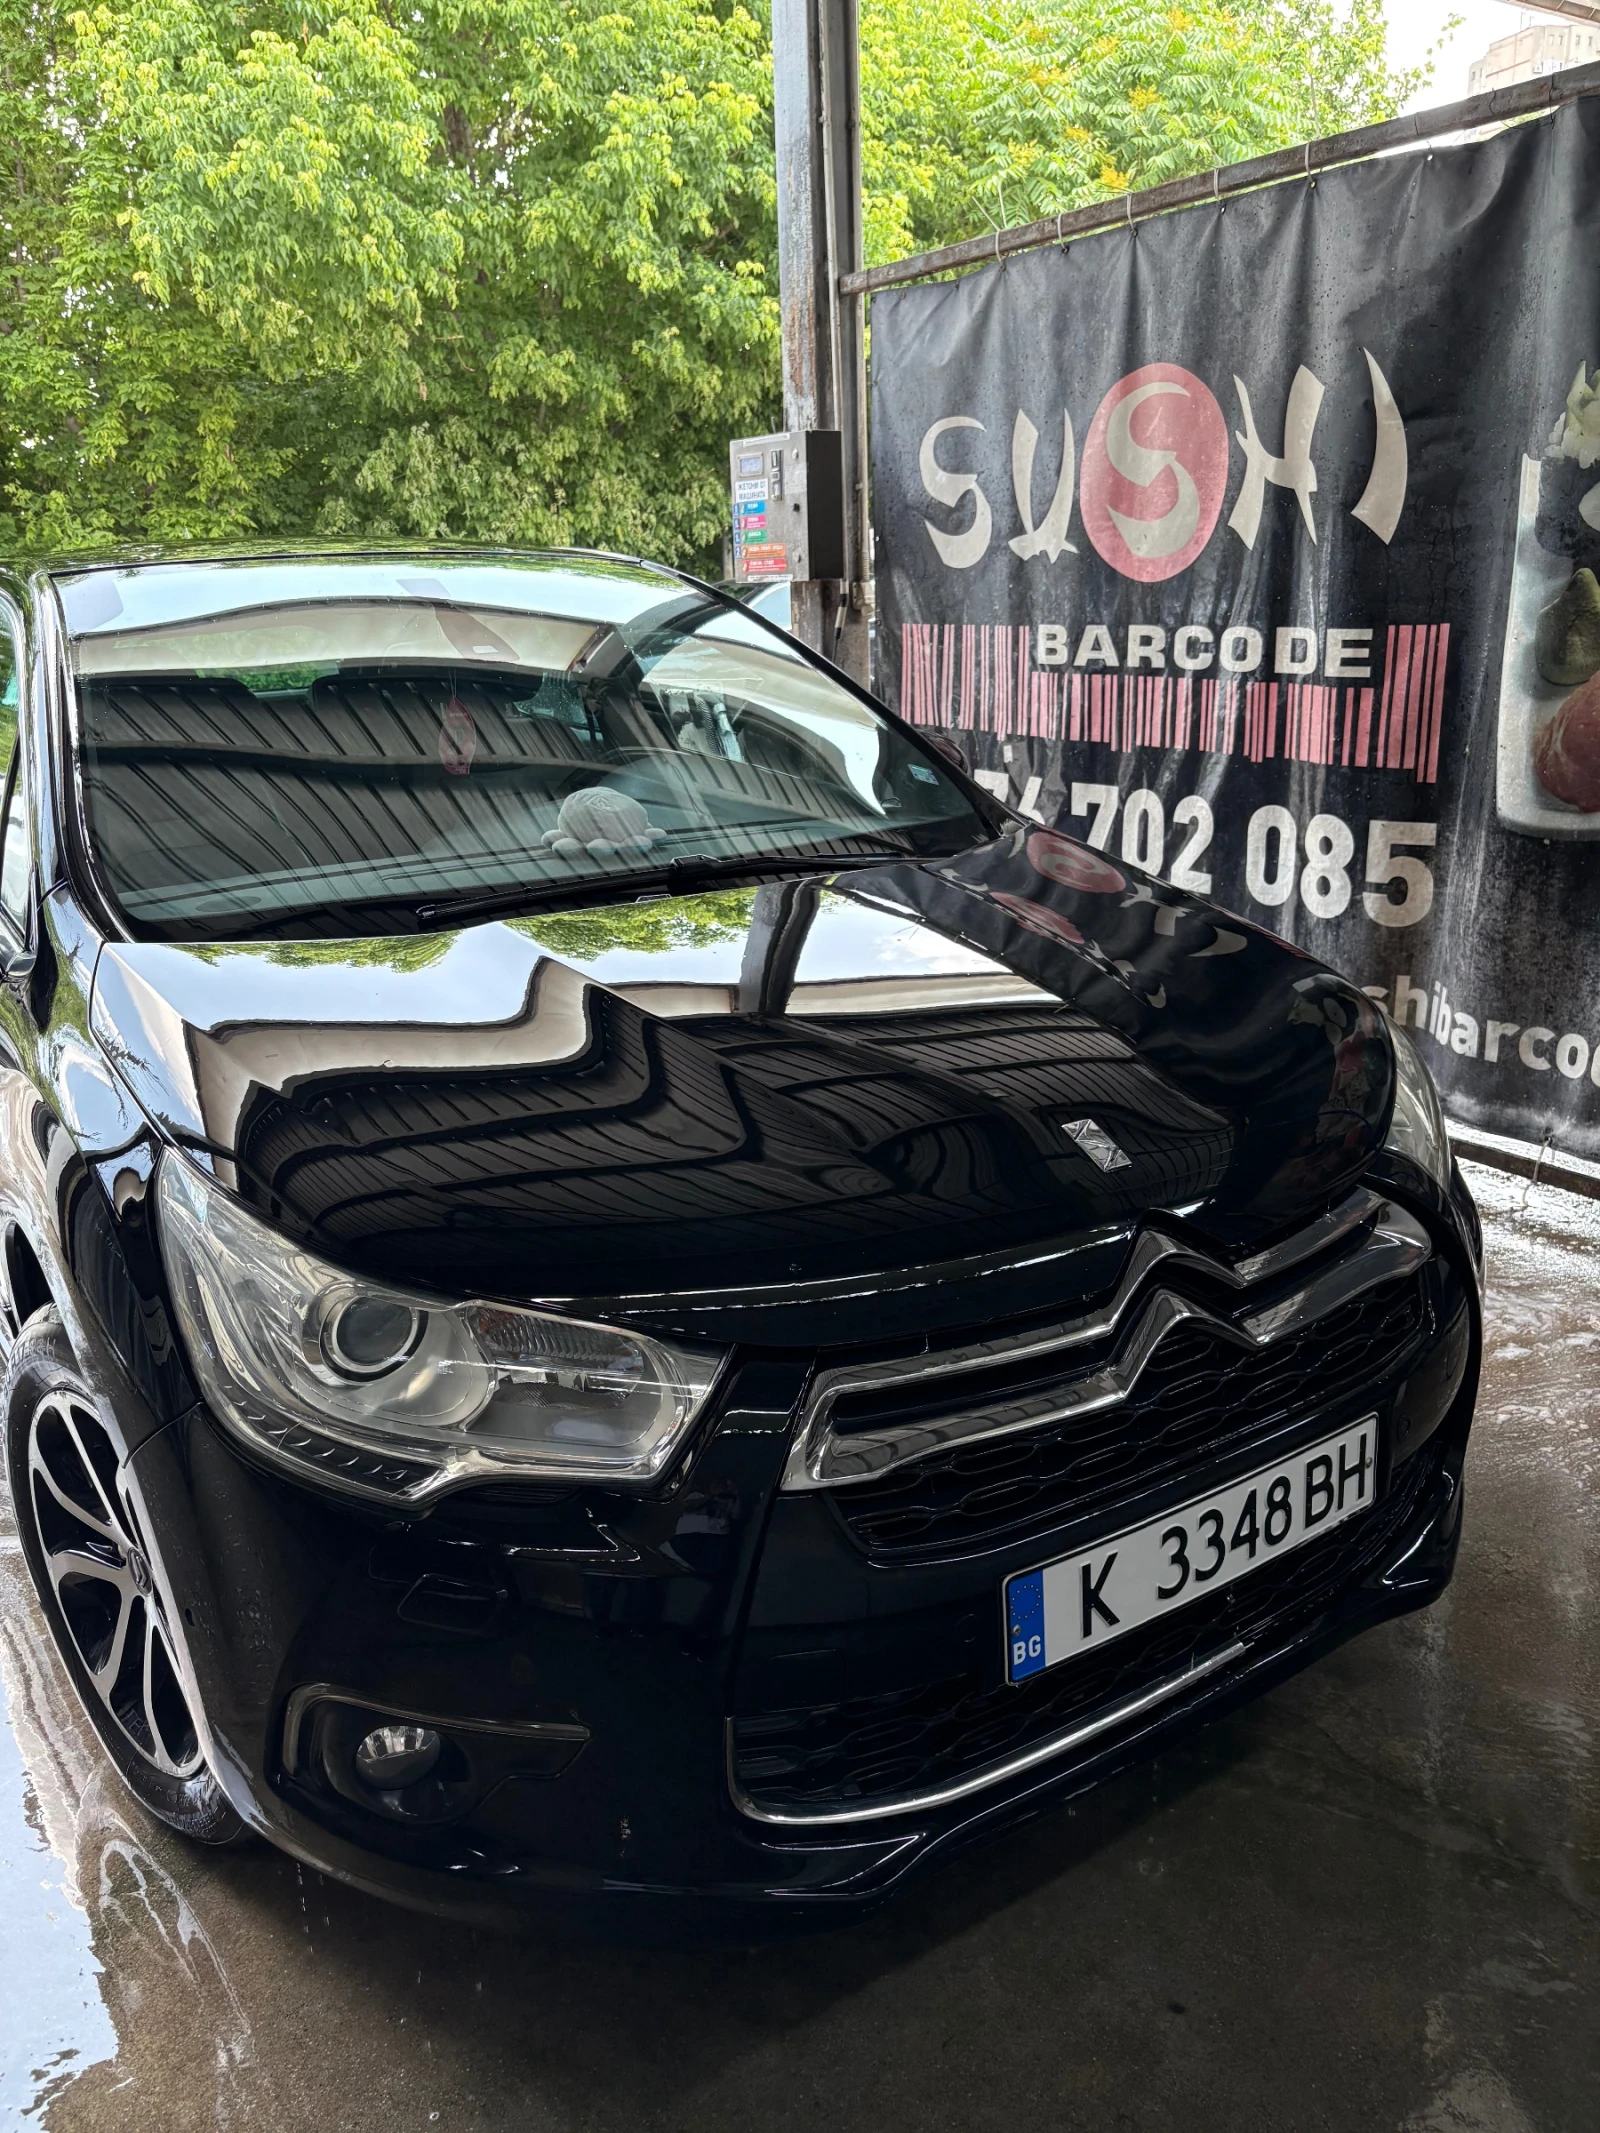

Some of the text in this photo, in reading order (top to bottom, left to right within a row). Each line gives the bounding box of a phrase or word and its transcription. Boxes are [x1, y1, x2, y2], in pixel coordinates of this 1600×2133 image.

[919, 347, 1408, 570] SUSHI
[1036, 624, 1374, 679] BARCODE
[1071, 782, 1214, 895] 702
[1245, 805, 1437, 928] 085
[1361, 974, 1600, 1089] hibarco
[1080, 1432, 1368, 1639] K 3348 BH
[1012, 1634, 1041, 1666] BG
